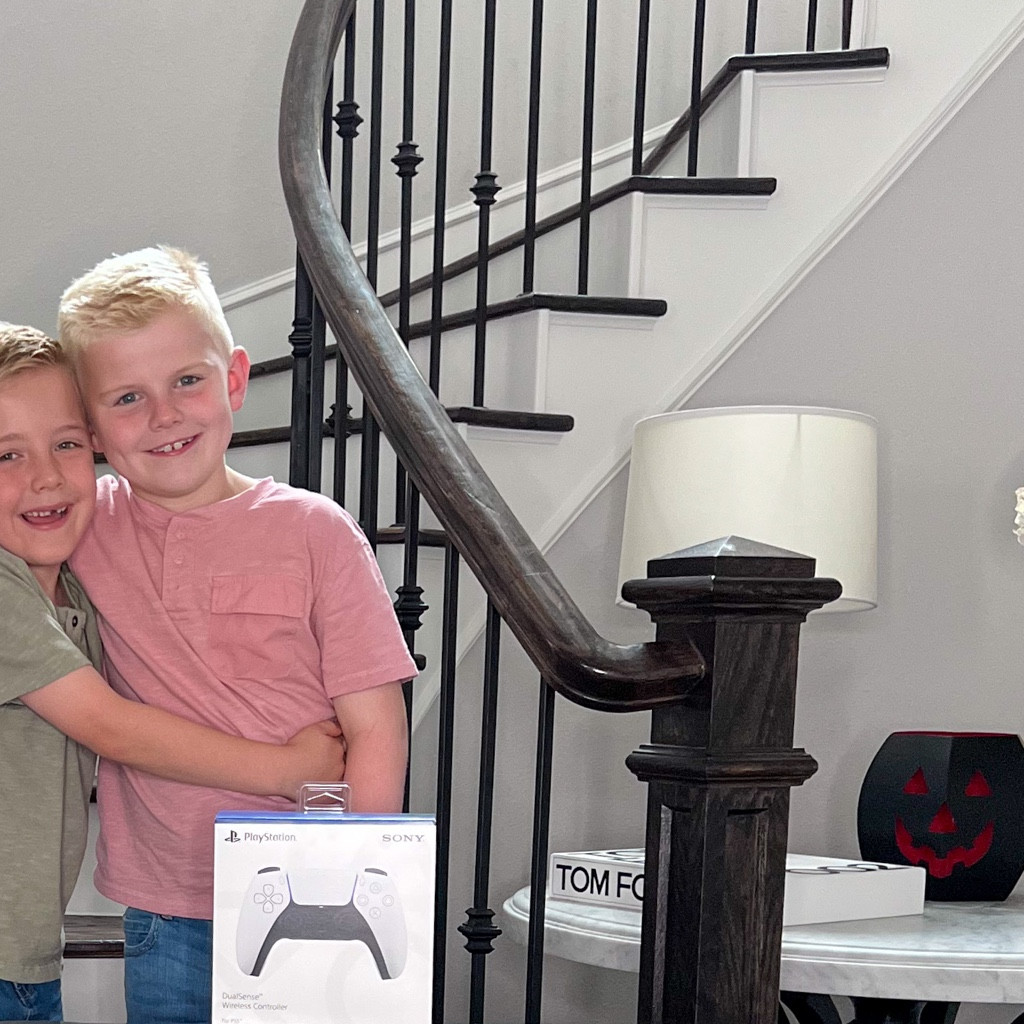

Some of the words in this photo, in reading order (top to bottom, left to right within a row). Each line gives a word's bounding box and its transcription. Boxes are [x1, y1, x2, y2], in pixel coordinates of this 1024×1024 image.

[244, 832, 297, 843] PlayStation
[382, 834, 425, 842] SONY
[556, 864, 610, 896] TOM
[617, 872, 645, 901] FO
[222, 1002, 252, 1010] Wireless
[252, 1002, 288, 1010] Controller
